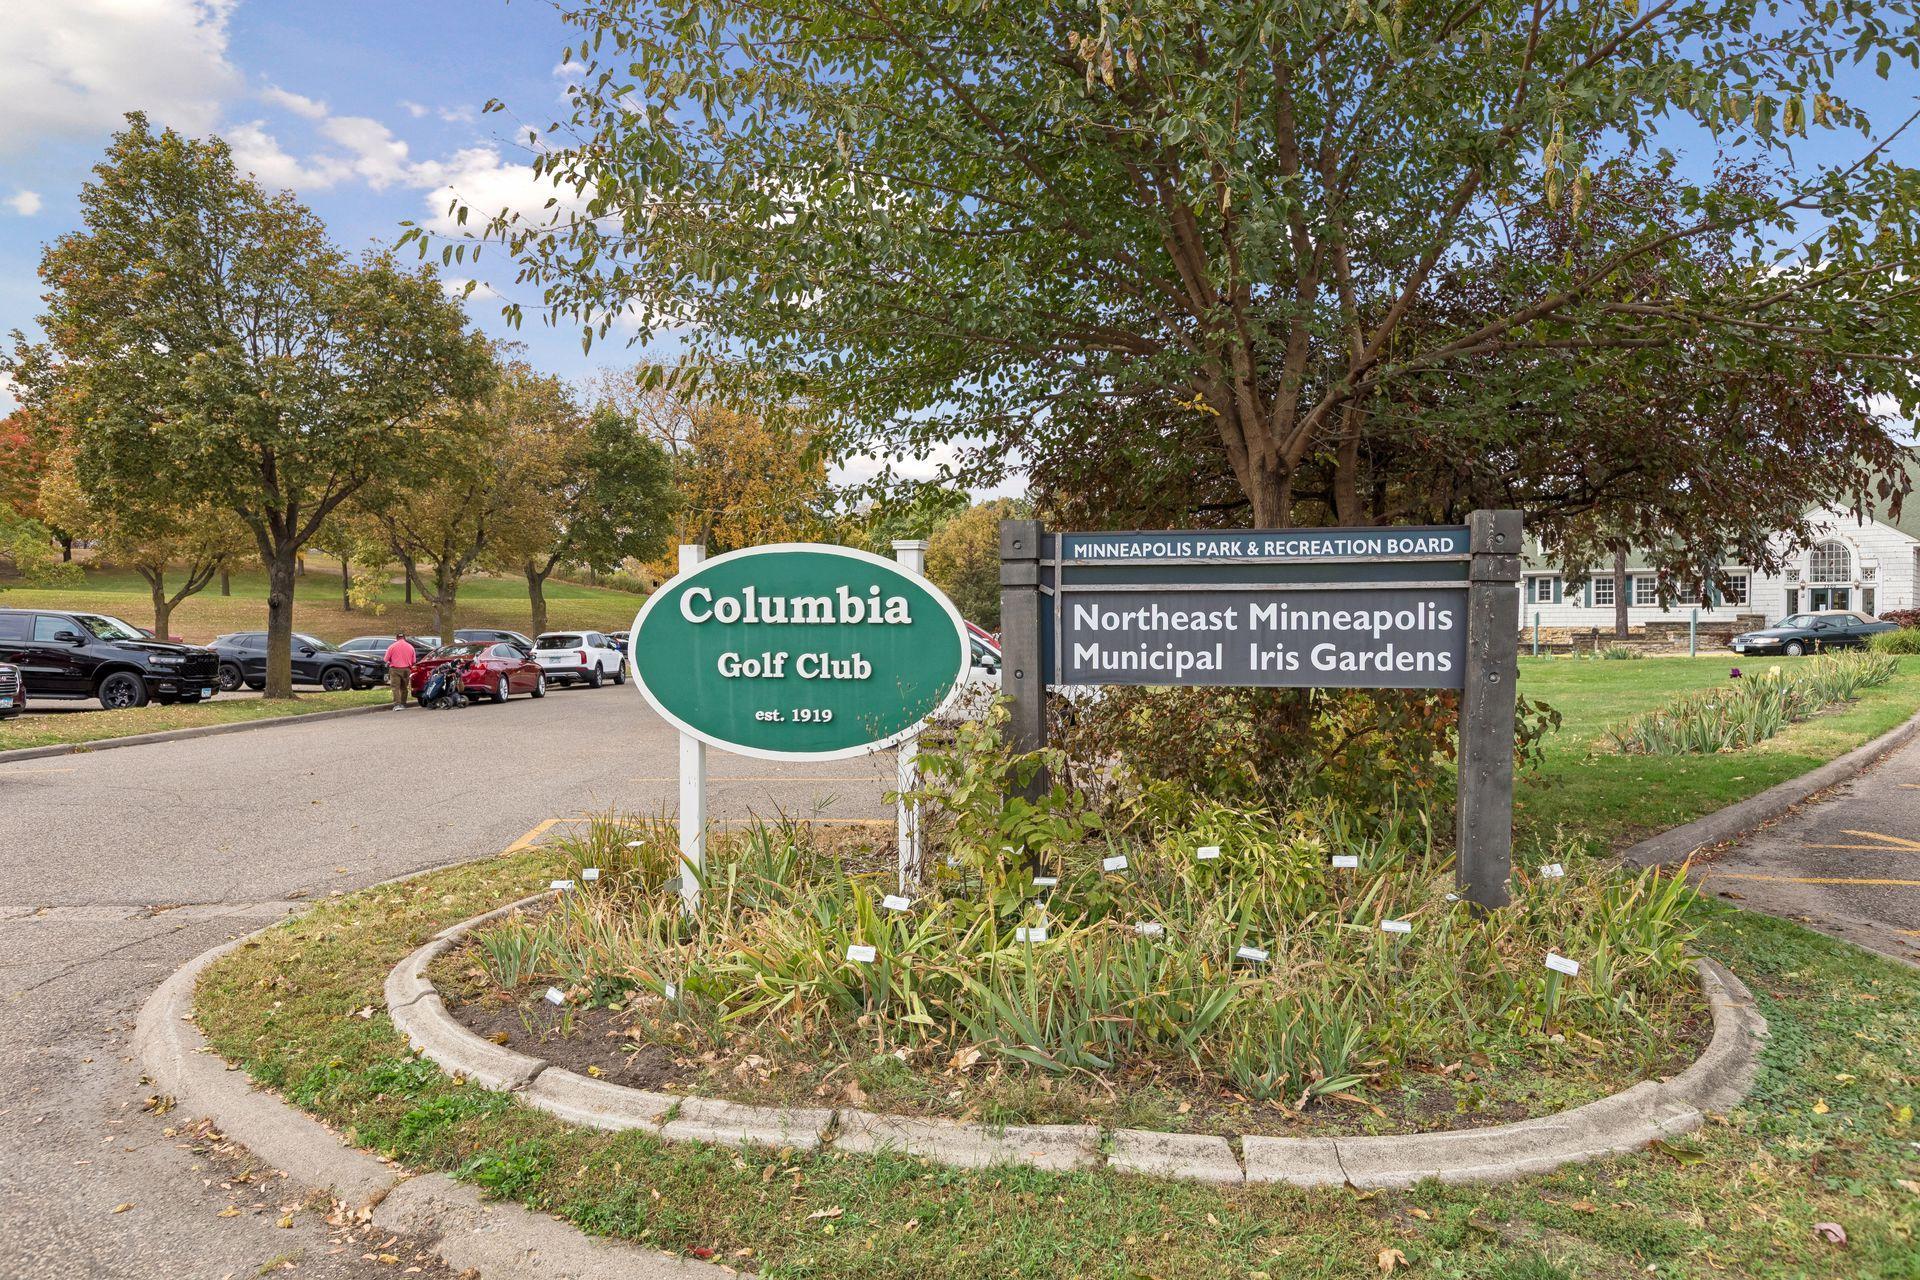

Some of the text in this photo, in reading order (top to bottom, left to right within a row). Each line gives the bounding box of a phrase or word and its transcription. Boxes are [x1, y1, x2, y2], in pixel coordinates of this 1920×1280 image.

[1074, 537, 1454, 558] MINNEAPOLIS PARK & RECREATION BOARD
[679, 584, 912, 624] Columbia
[1073, 601, 1453, 639] Northeast Minneapolis
[717, 651, 872, 680] Golf Club
[1073, 642, 1452, 678] Municipal Iris Gardens
[754, 708, 833, 723] est. 1919
